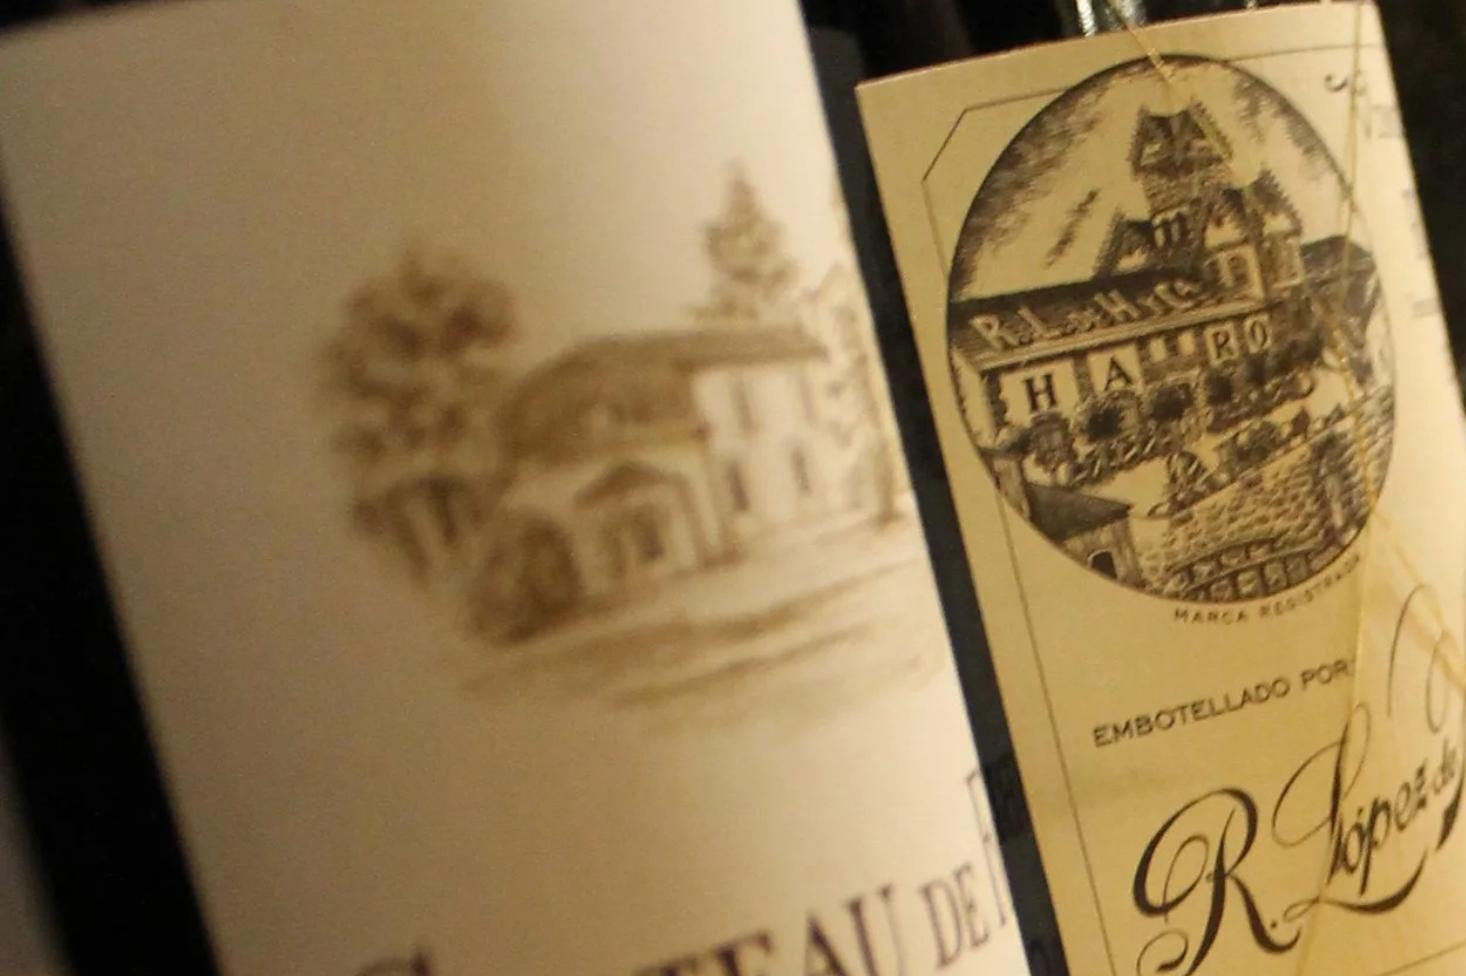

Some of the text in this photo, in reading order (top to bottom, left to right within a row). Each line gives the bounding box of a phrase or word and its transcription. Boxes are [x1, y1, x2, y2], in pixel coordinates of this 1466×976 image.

[1173, 607, 1248, 626] MARCA
[1091, 676, 1292, 749] EMBOTELLADO
[918, 861, 990, 971] DE
